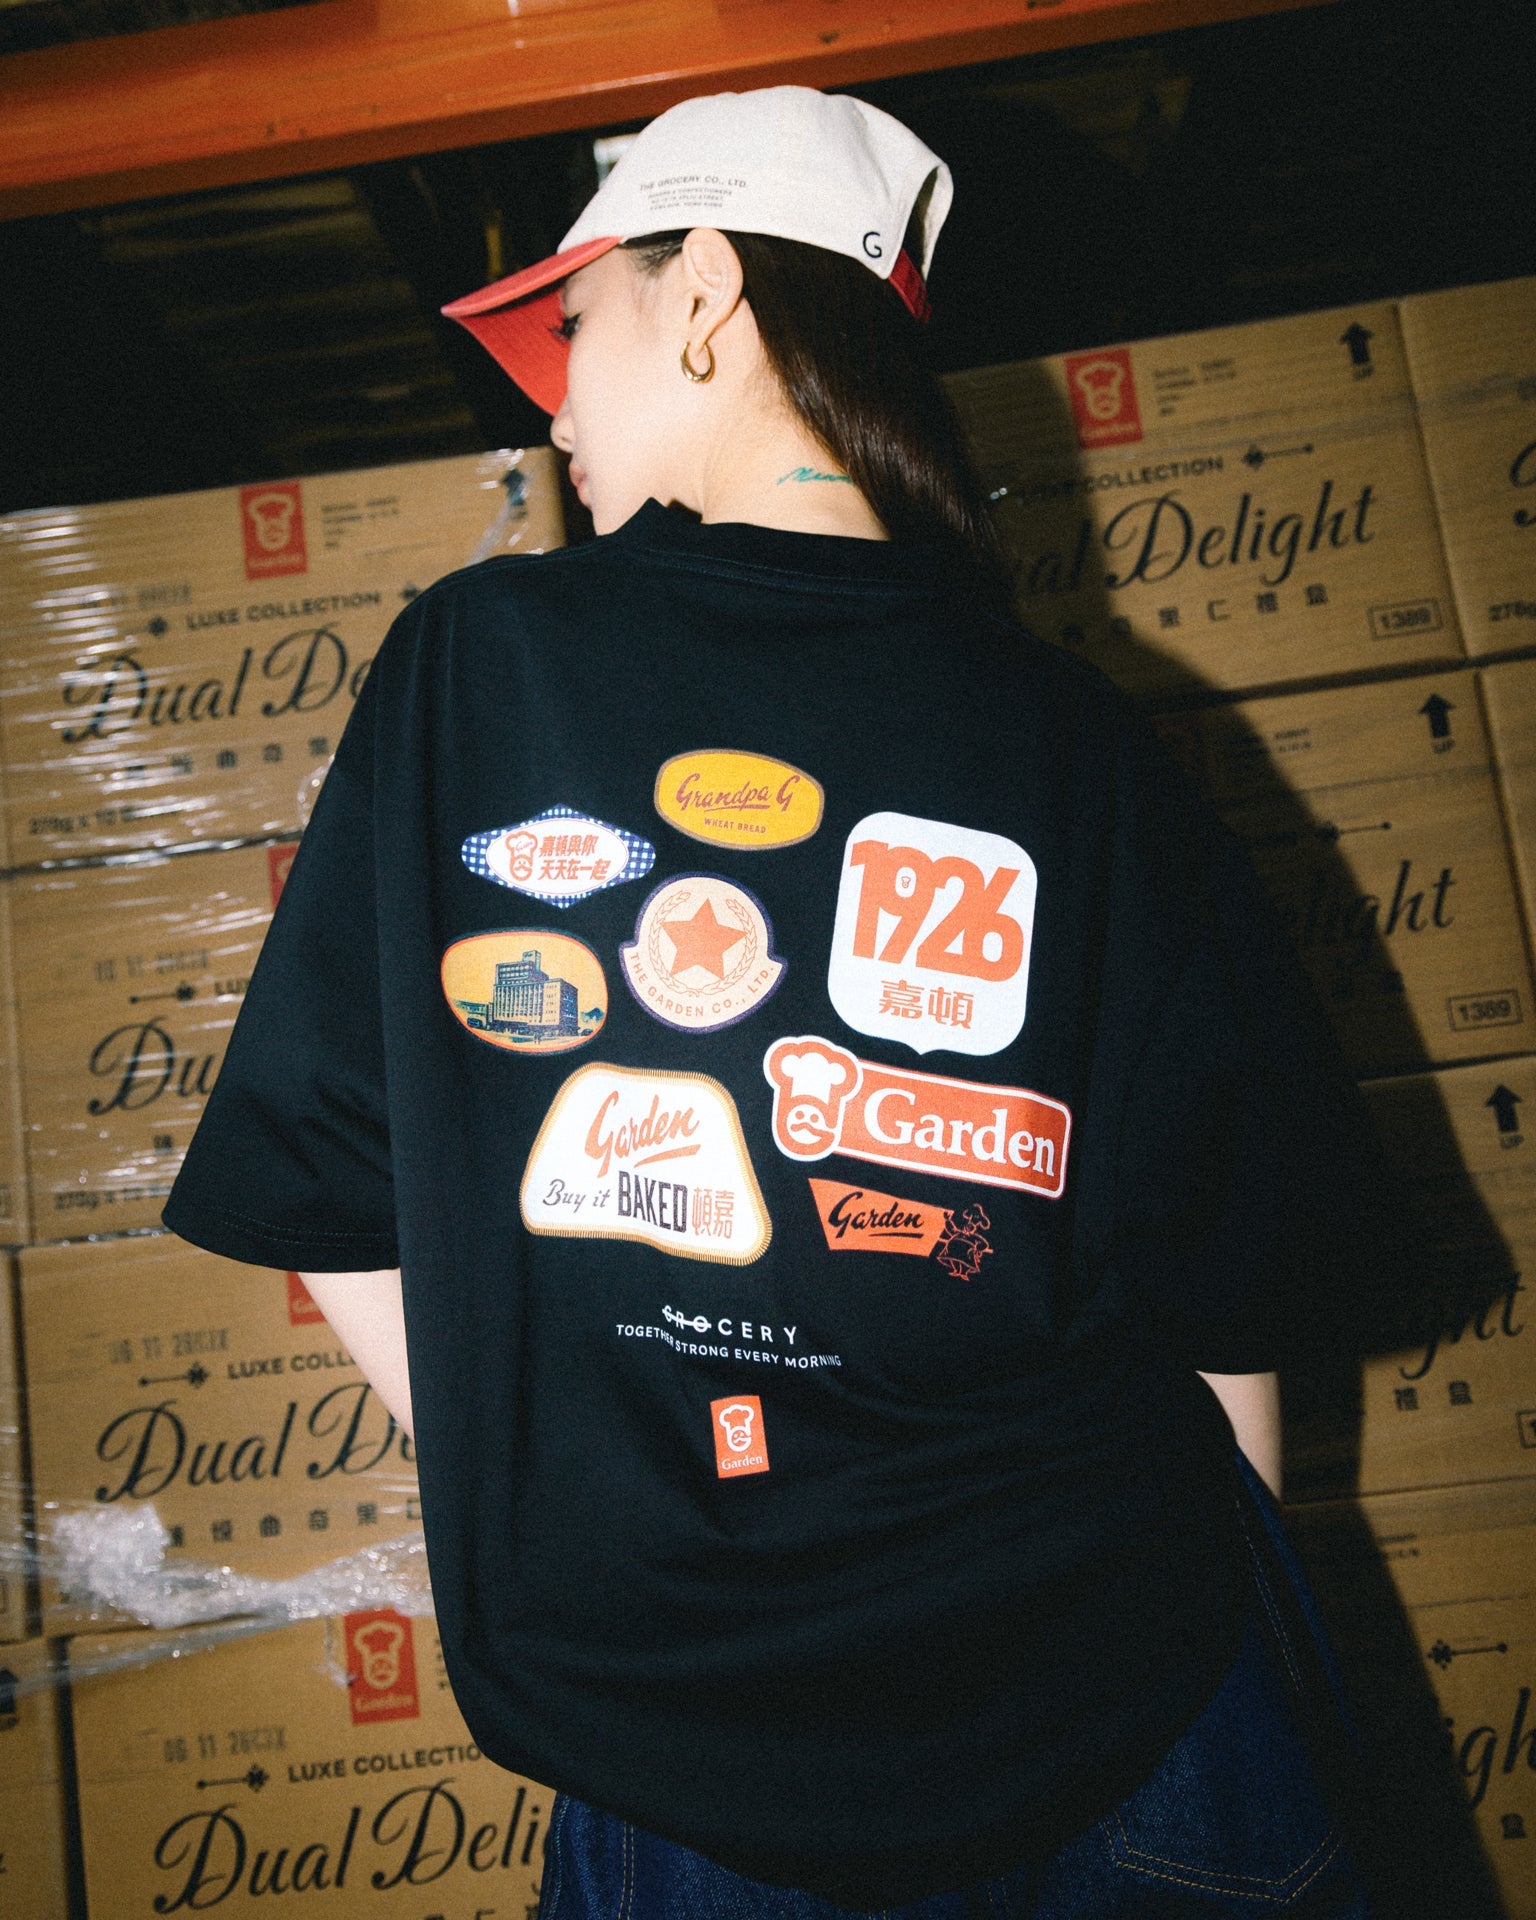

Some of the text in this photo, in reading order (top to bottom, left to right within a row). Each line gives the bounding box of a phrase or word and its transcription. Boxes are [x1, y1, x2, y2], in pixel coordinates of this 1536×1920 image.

[863, 231, 882, 258] G
[1103, 480, 1379, 589] Delight
[187, 591, 381, 630] LUXE COLLECTION
[676, 773, 801, 812] Grandpa G
[538, 834, 599, 858] 嘉頓與你
[704, 818, 767, 834] WHEAT BREAD
[538, 859, 611, 881] 天天在一起
[850, 839, 1024, 982] 1926
[630, 953, 648, 984] THE
[648, 986, 704, 1017] GARDEN
[747, 967, 774, 994] LTD.
[878, 979, 974, 1030] 嘉頓
[584, 1090, 700, 1179] Garden
[863, 1087, 1054, 1177] Garden
[542, 1178, 586, 1213] Buy
[592, 1186, 611, 1208] it
[617, 1170, 688, 1233] BAKED
[828, 1191, 924, 1239] Garden
[616, 1323, 842, 1369] TOGETHER STRONG EVERY MORNING
[662, 1304, 797, 1345] GROCERY
[228, 1356, 283, 1379] LUXE
[96, 1400, 297, 1502] Dual
[721, 1454, 763, 1471] Garden
[288, 1762, 348, 1784] LUXE
[153, 1777, 543, 1915] Dual Deli
